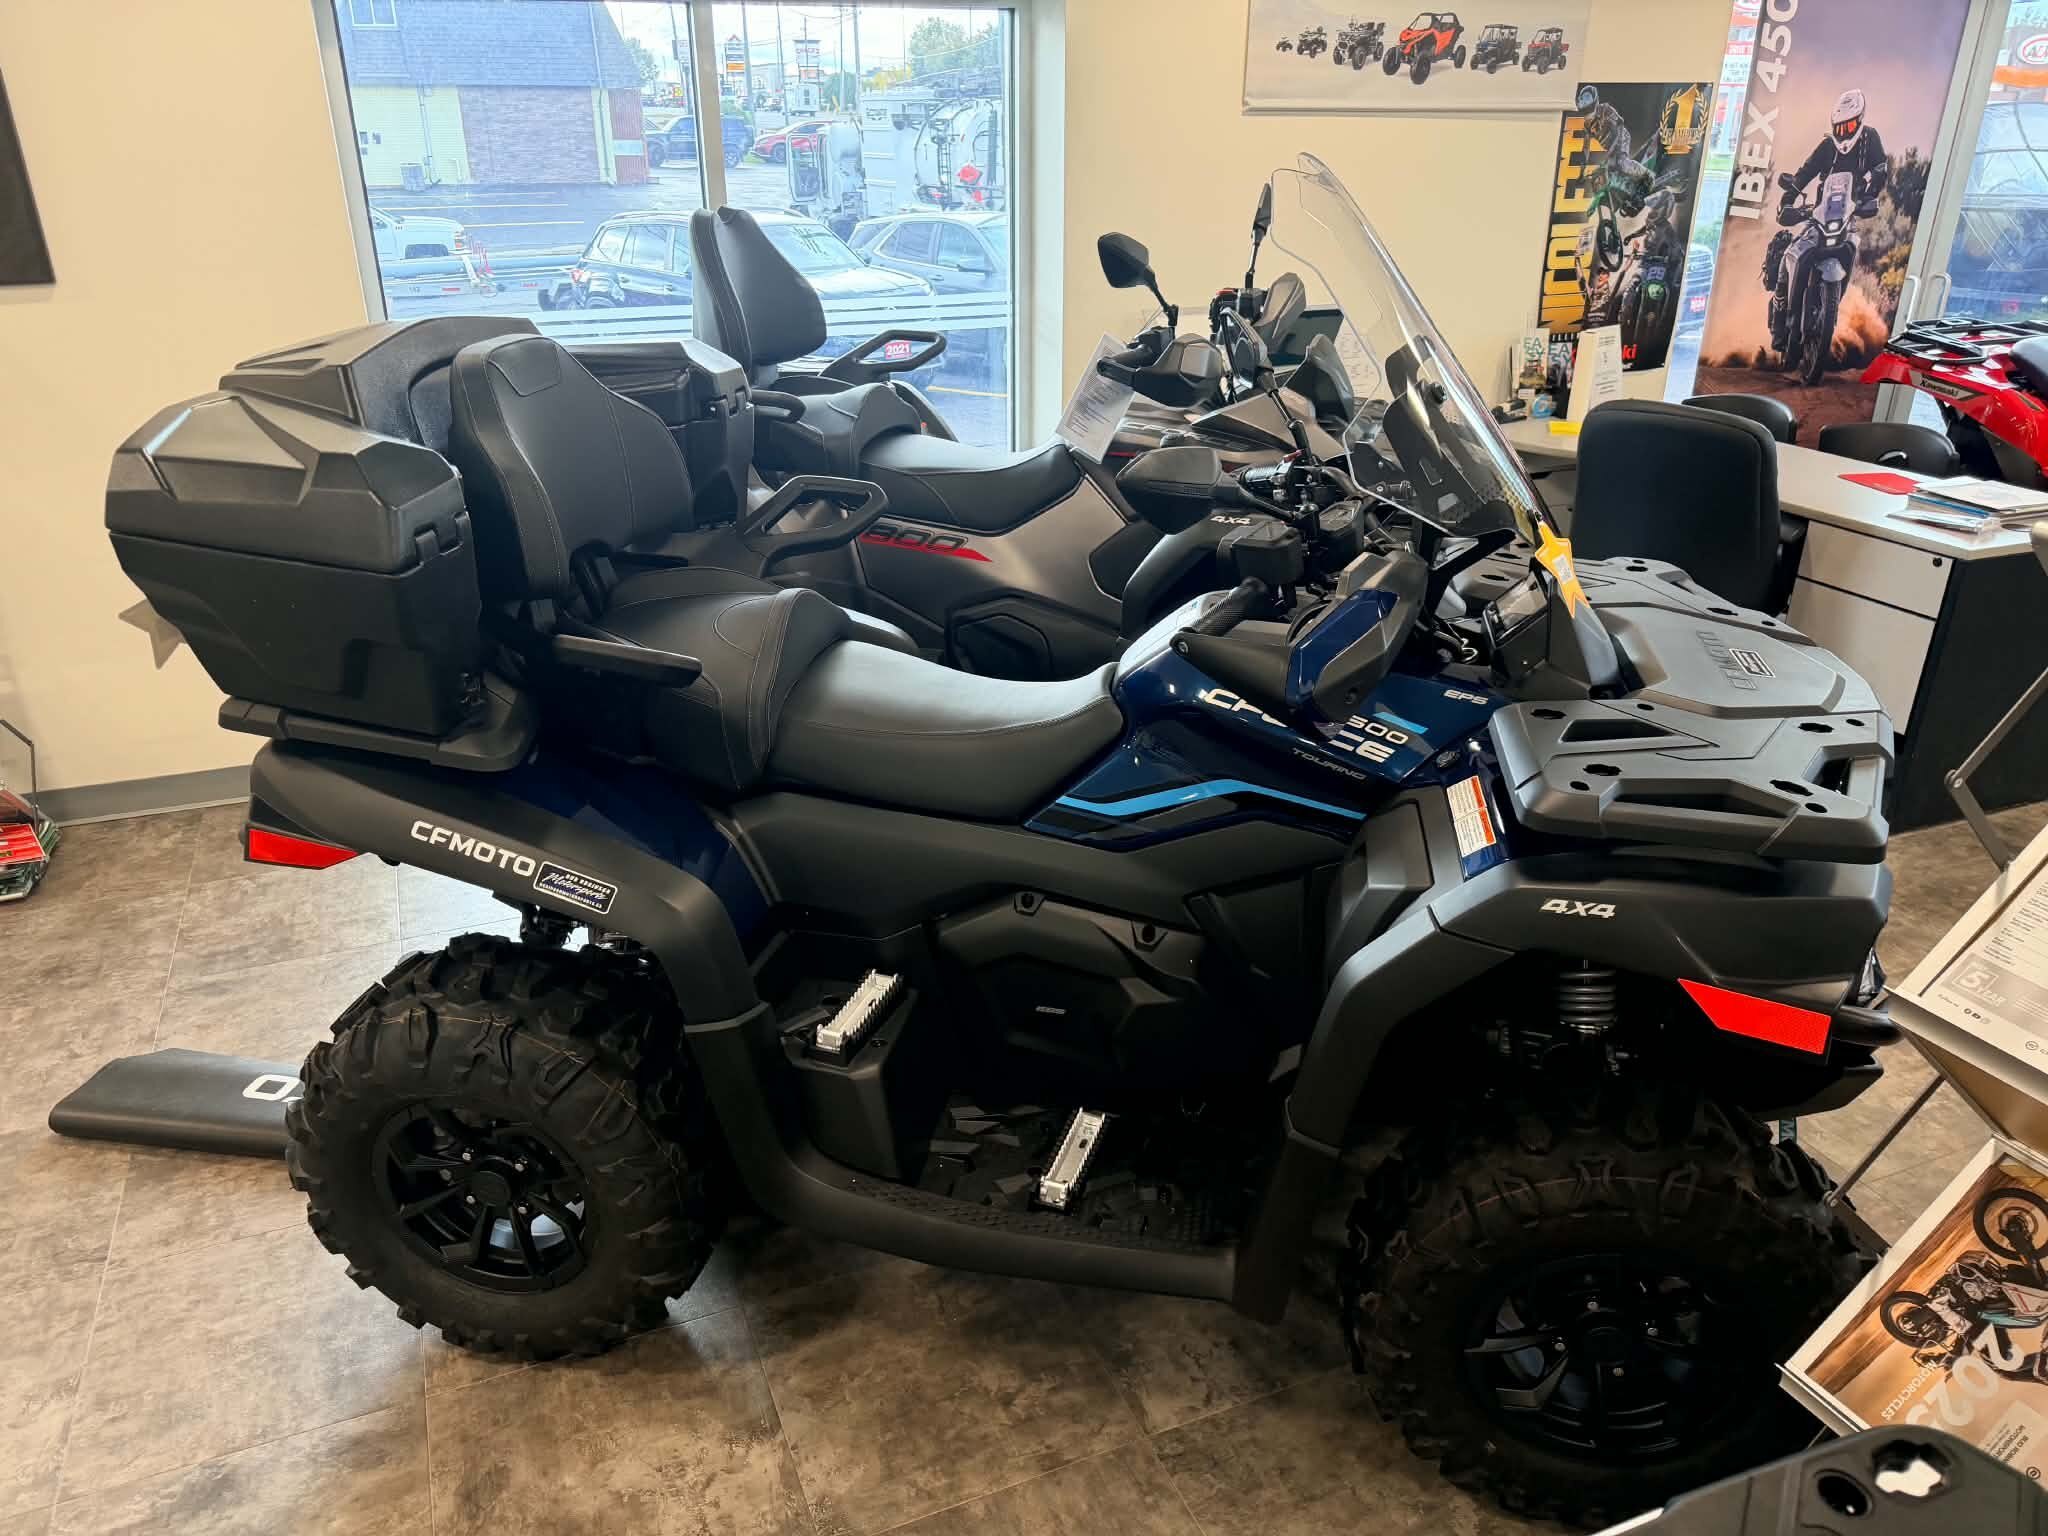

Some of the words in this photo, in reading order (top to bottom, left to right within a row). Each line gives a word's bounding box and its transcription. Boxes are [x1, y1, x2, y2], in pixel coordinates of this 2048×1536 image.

[1729, 101, 1780, 220] IBEX
[1756, 0, 1799, 93] 450
[887, 343, 911, 355] 2021
[1443, 689, 1489, 705] EPS
[1292, 747, 1368, 780] TOURING
[410, 820, 537, 877] CFMOTO
[1881, 1359, 1938, 1420] MOTORCYCLES
